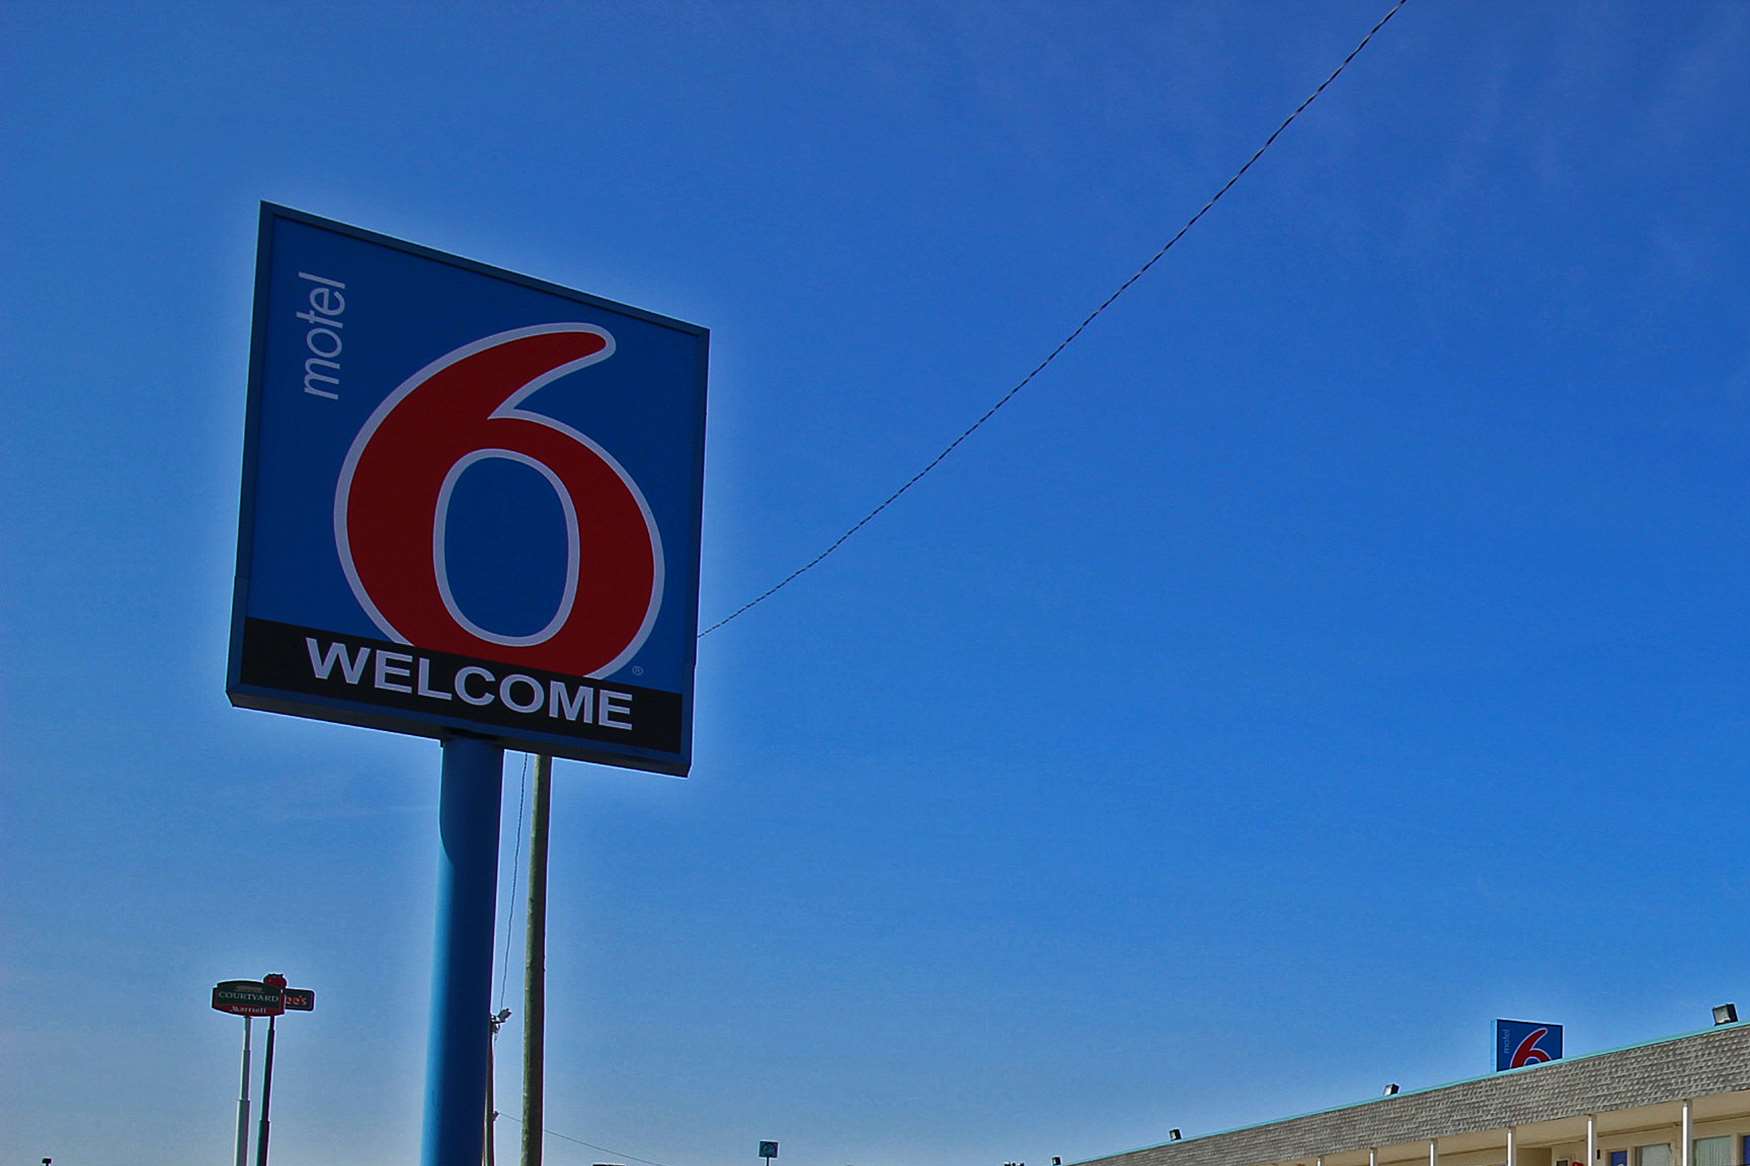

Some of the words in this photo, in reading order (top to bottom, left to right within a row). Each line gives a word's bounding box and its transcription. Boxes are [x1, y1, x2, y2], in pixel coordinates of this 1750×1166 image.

[296, 271, 346, 400] motel
[333, 321, 665, 680] 6
[305, 637, 633, 731] WELCOME
[218, 993, 280, 1002] COURTYARD
[1510, 1027, 1552, 1068] 6
